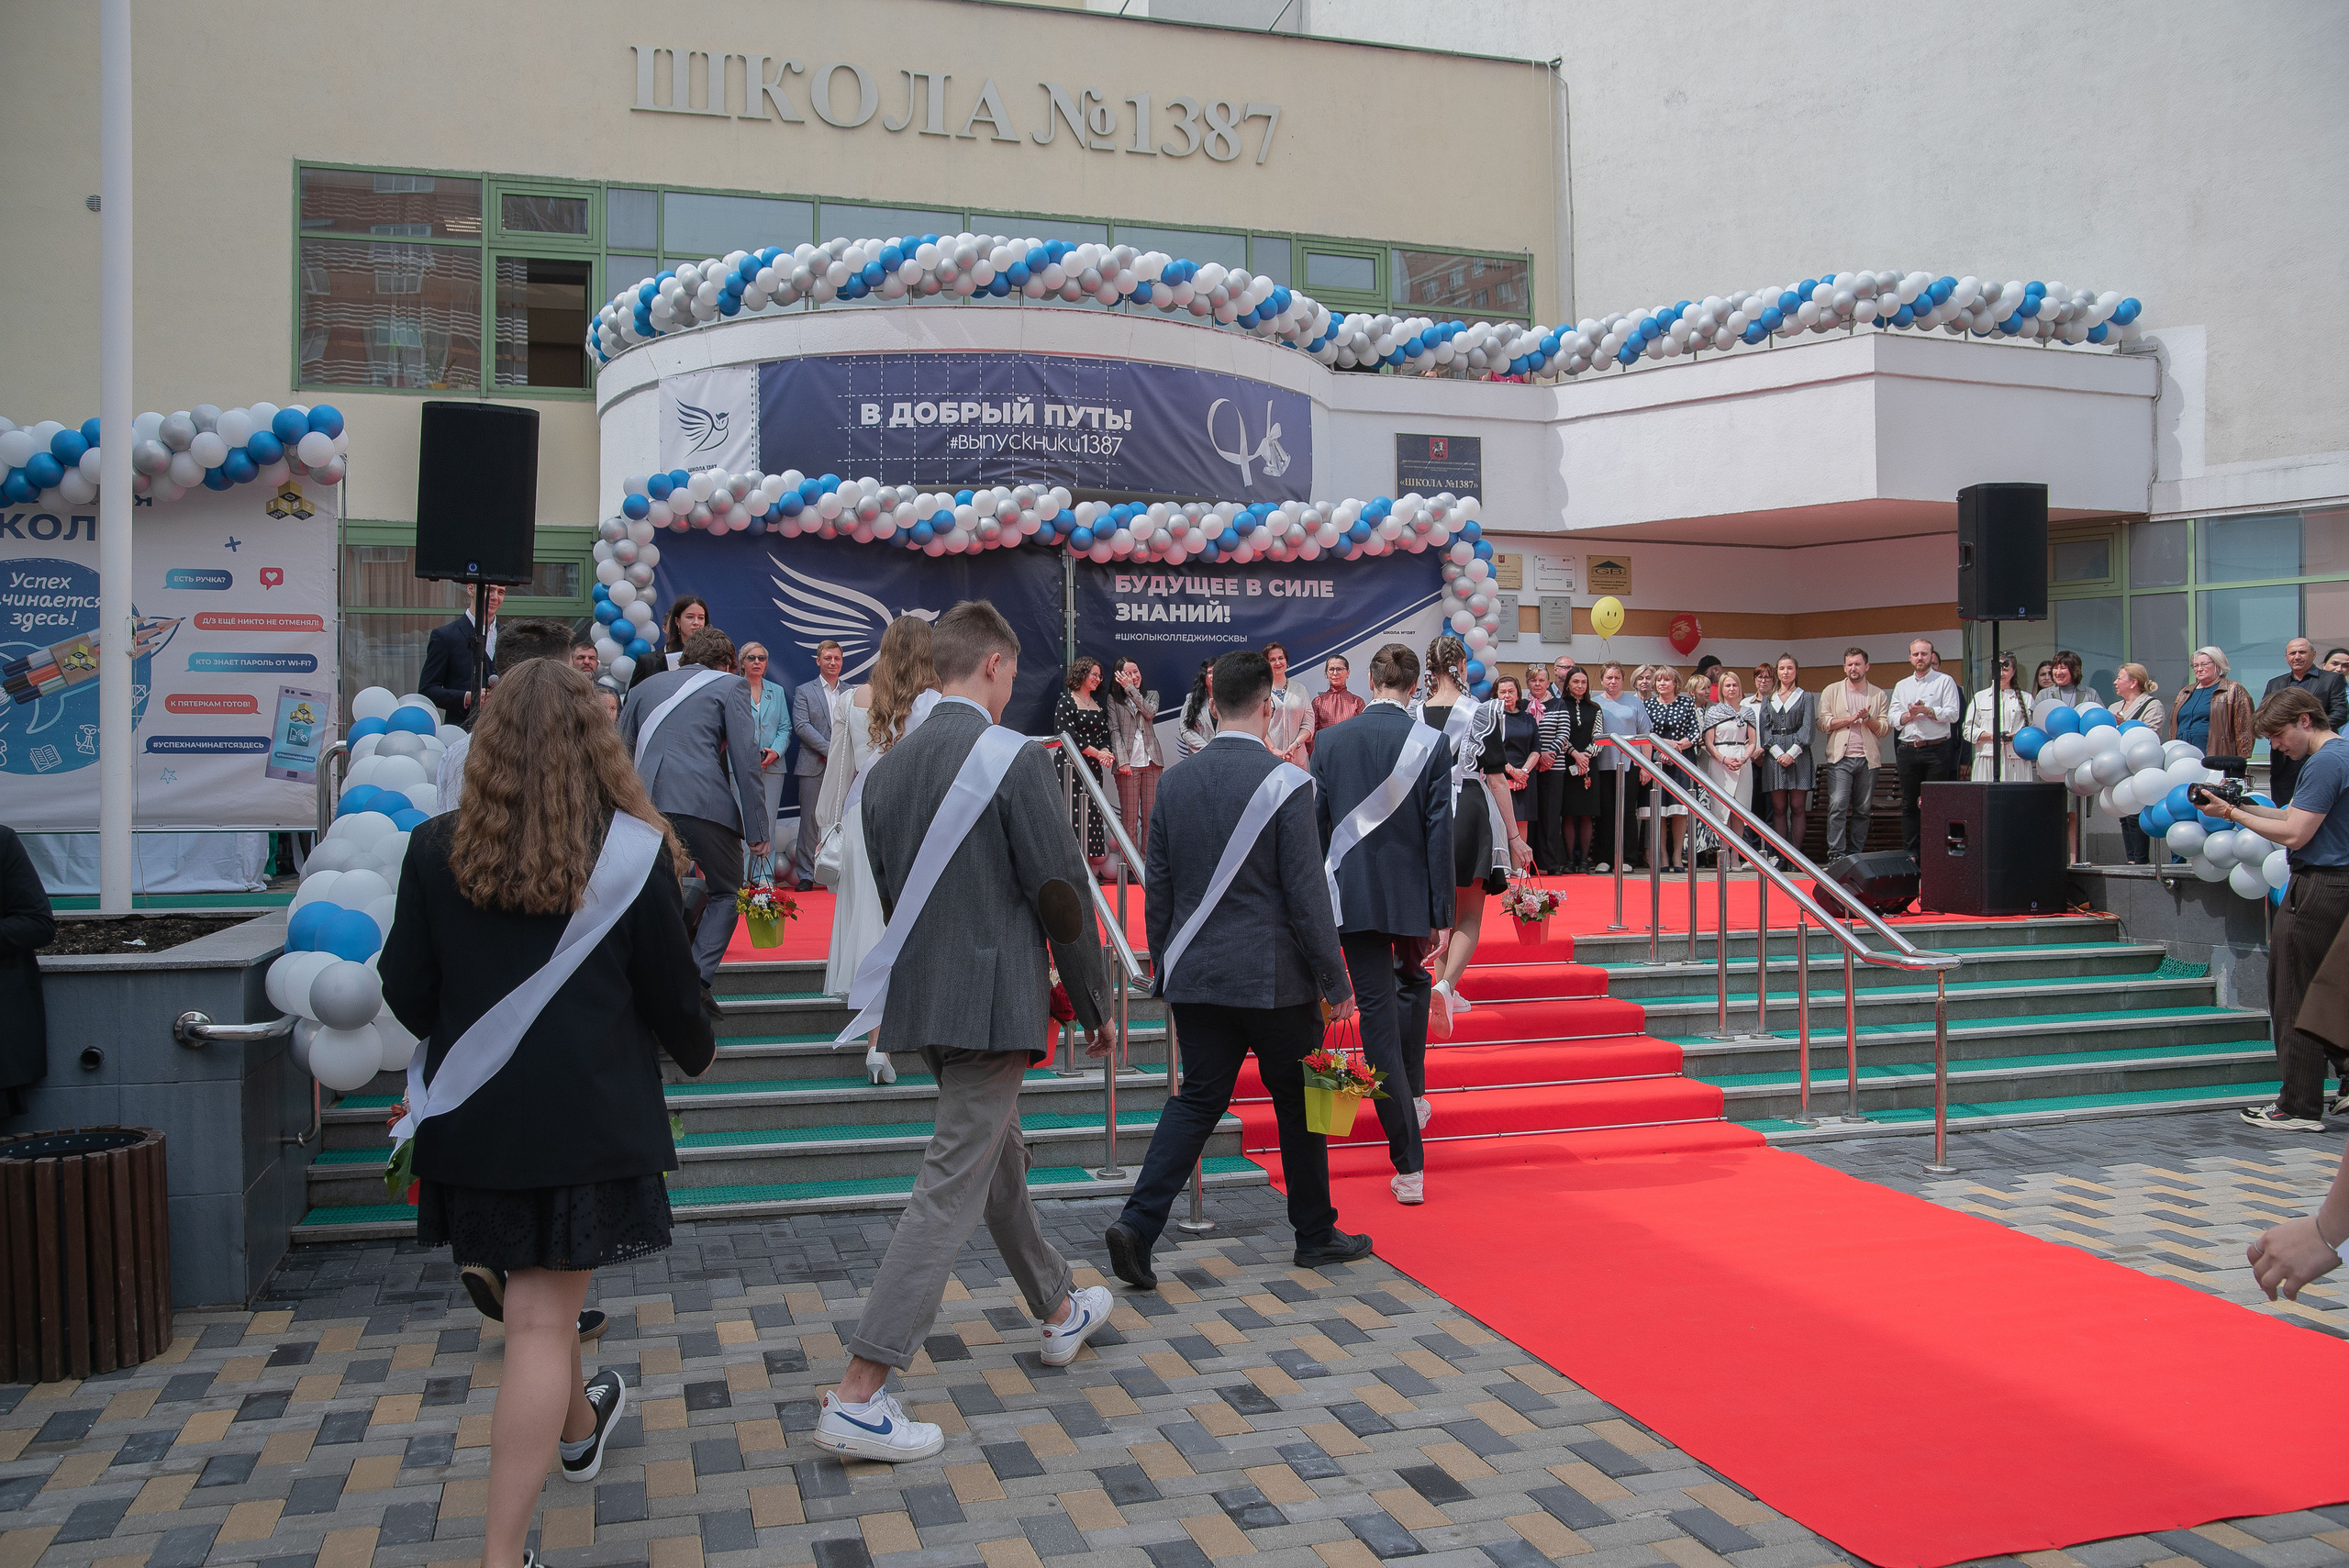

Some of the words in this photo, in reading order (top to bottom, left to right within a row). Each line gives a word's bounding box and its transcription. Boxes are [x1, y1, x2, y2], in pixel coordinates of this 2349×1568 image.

[630, 45, 1021, 143] ШКОЛА
[1031, 82, 1283, 164] №1387
[861, 403, 880, 425] В
[888, 396, 1034, 428] ДОБРЫЙ
[1044, 404, 1132, 430] ПУТЬ!
[1399, 477, 1442, 488] «ШКОЛА
[1444, 479, 1478, 489] №1387»
[9, 572, 72, 590] Успех
[1115, 574, 1239, 598] БУДУЩЕЕ
[1246, 578, 1262, 596] В
[1268, 579, 1334, 598] СИЛЕ
[0, 594, 100, 608] чинается
[1115, 600, 1231, 623] ЗНАНИЙ!
[9, 610, 77, 632] здесь!
[202, 617, 217, 626] Д/З
[217, 617, 236, 626] ЕЩЁ
[278, 618, 319, 627] ОТМЕНЯЛ!
[1115, 632, 1248, 643] #ШКОЛЫКОЛЛЕДЖИМОСКВЫ
[152, 741, 264, 750] #УСПЕХНАЧИНАЕТСЯЗДЕСЬ
